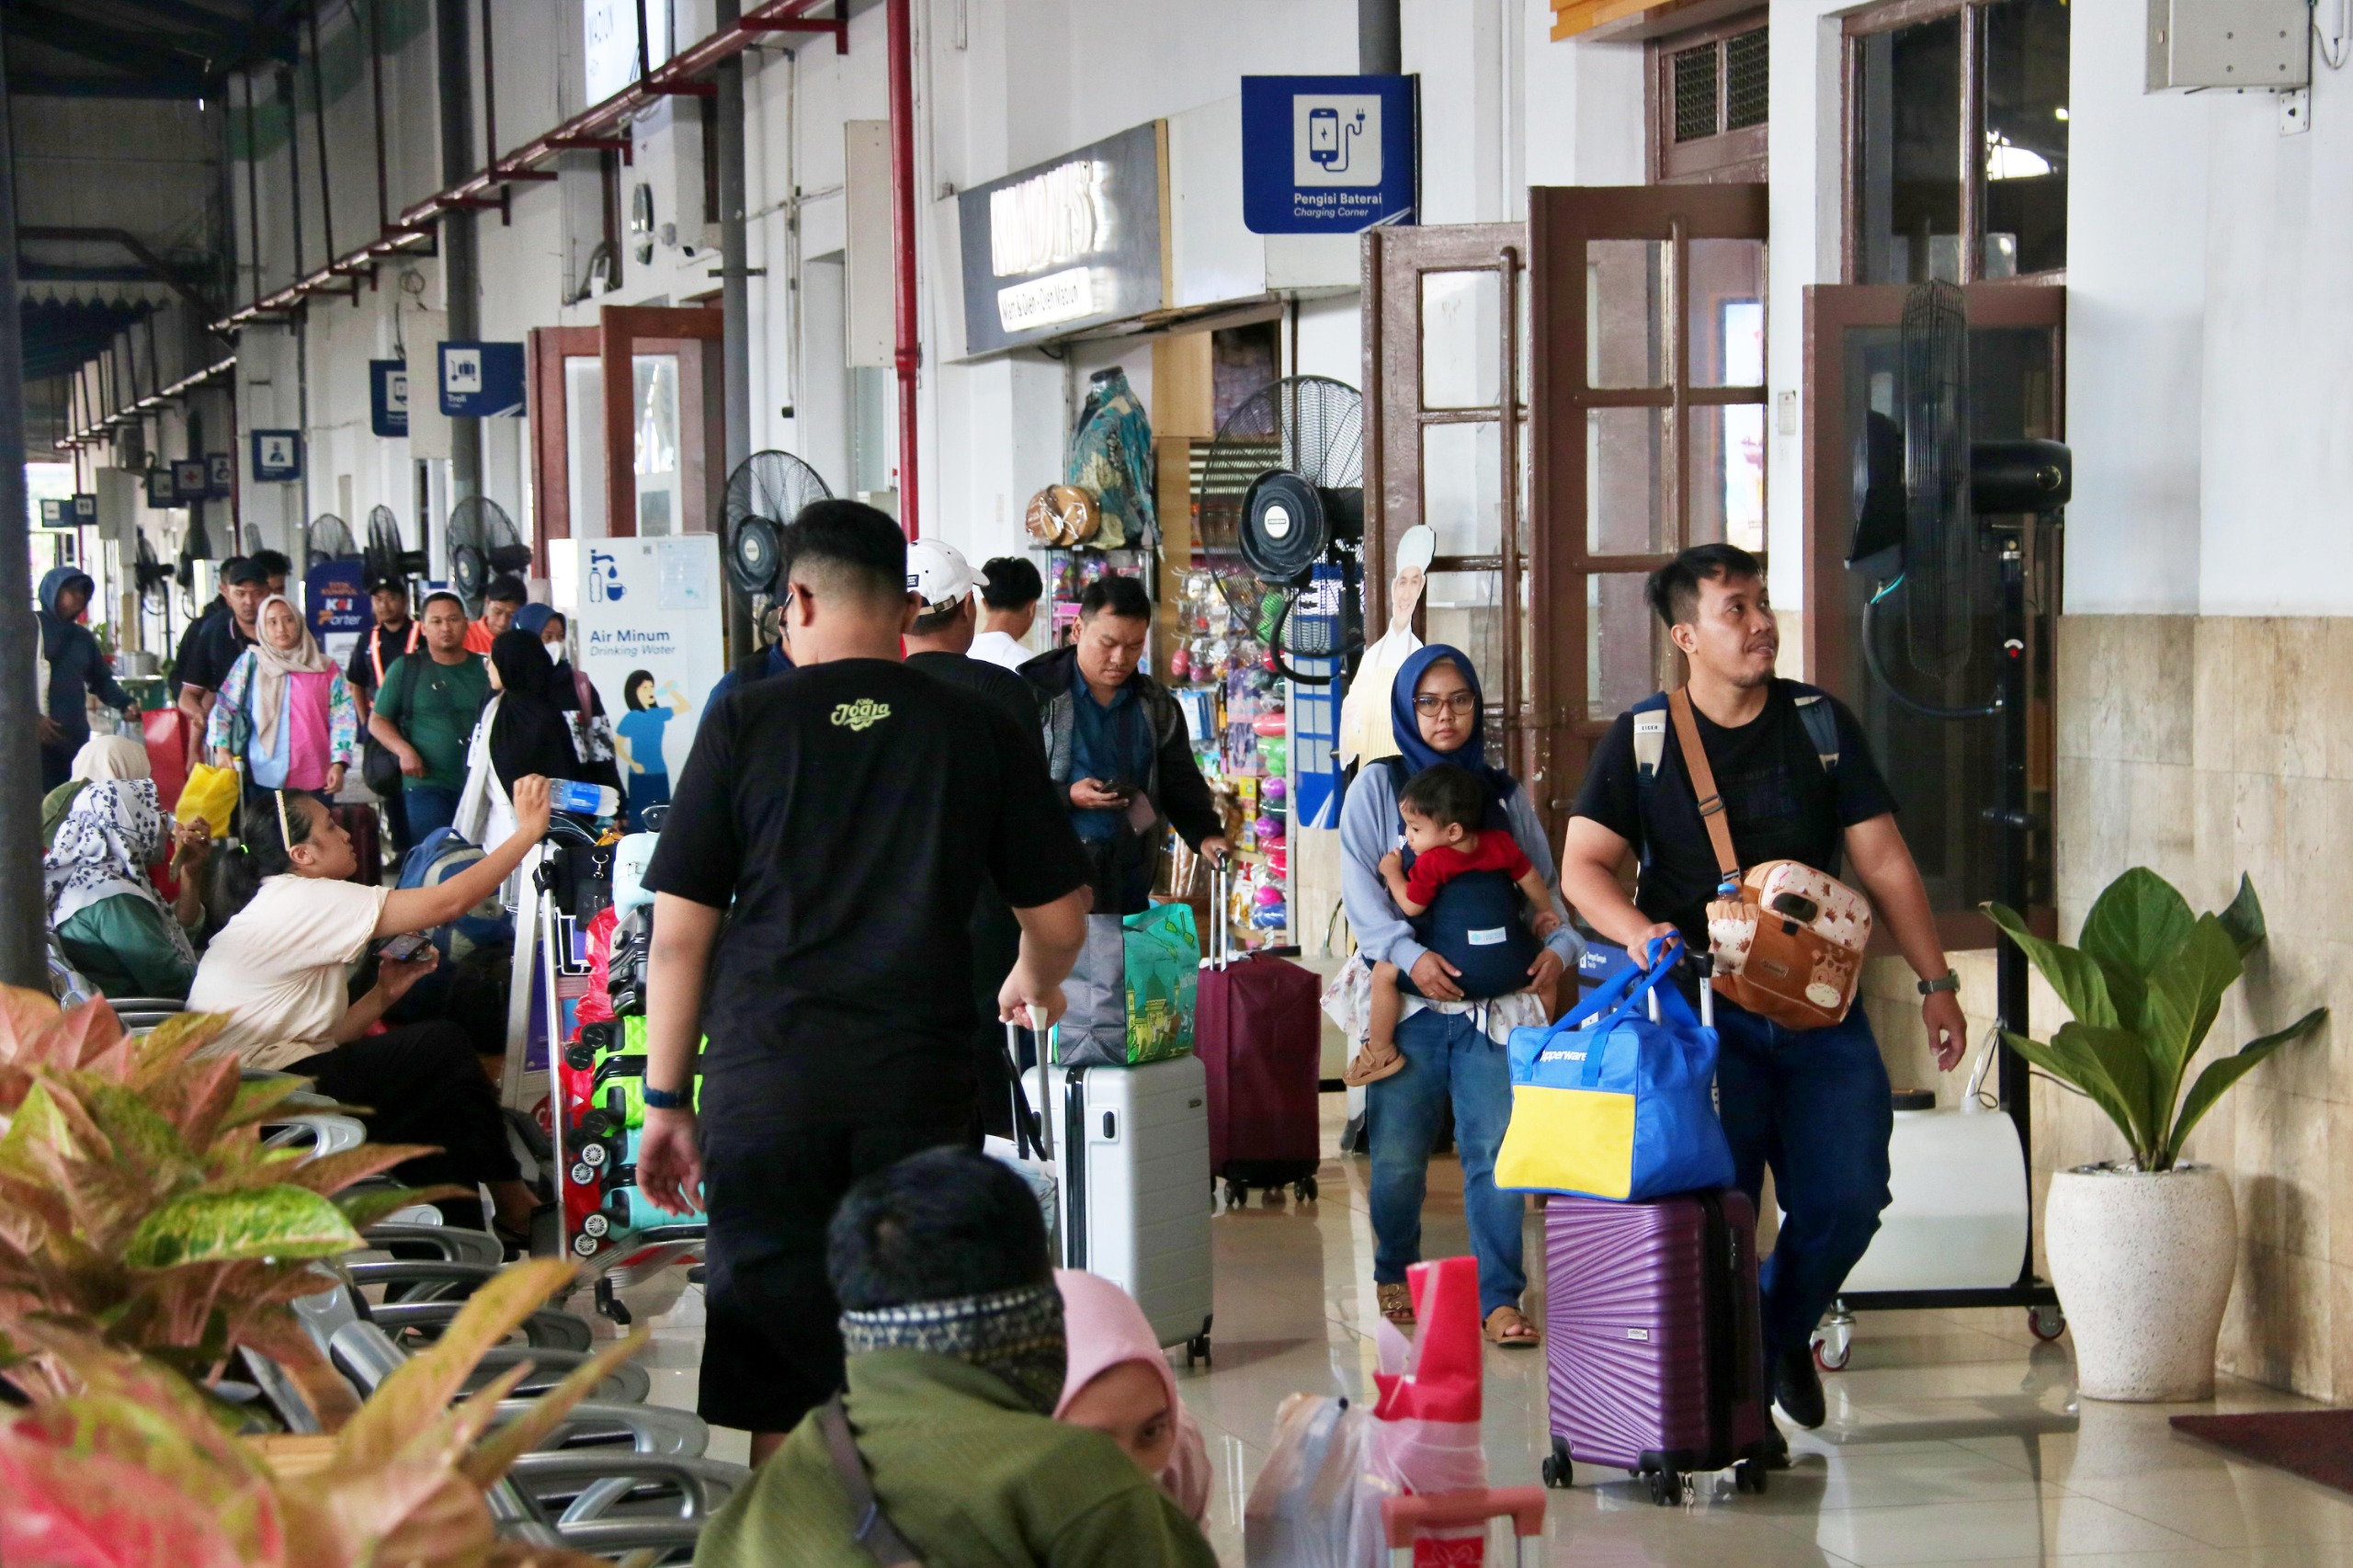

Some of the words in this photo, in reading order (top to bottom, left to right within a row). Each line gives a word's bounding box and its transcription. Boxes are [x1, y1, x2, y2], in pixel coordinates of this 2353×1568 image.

[1294, 192, 1336, 207] Pengisi
[1340, 192, 1381, 204] Baterai
[1294, 207, 1336, 219] Charging
[1337, 207, 1369, 217] Corner
[590, 631, 612, 642] Air
[617, 630, 670, 642] Minum
[590, 645, 638, 657] Drinking
[642, 645, 676, 655] Water
